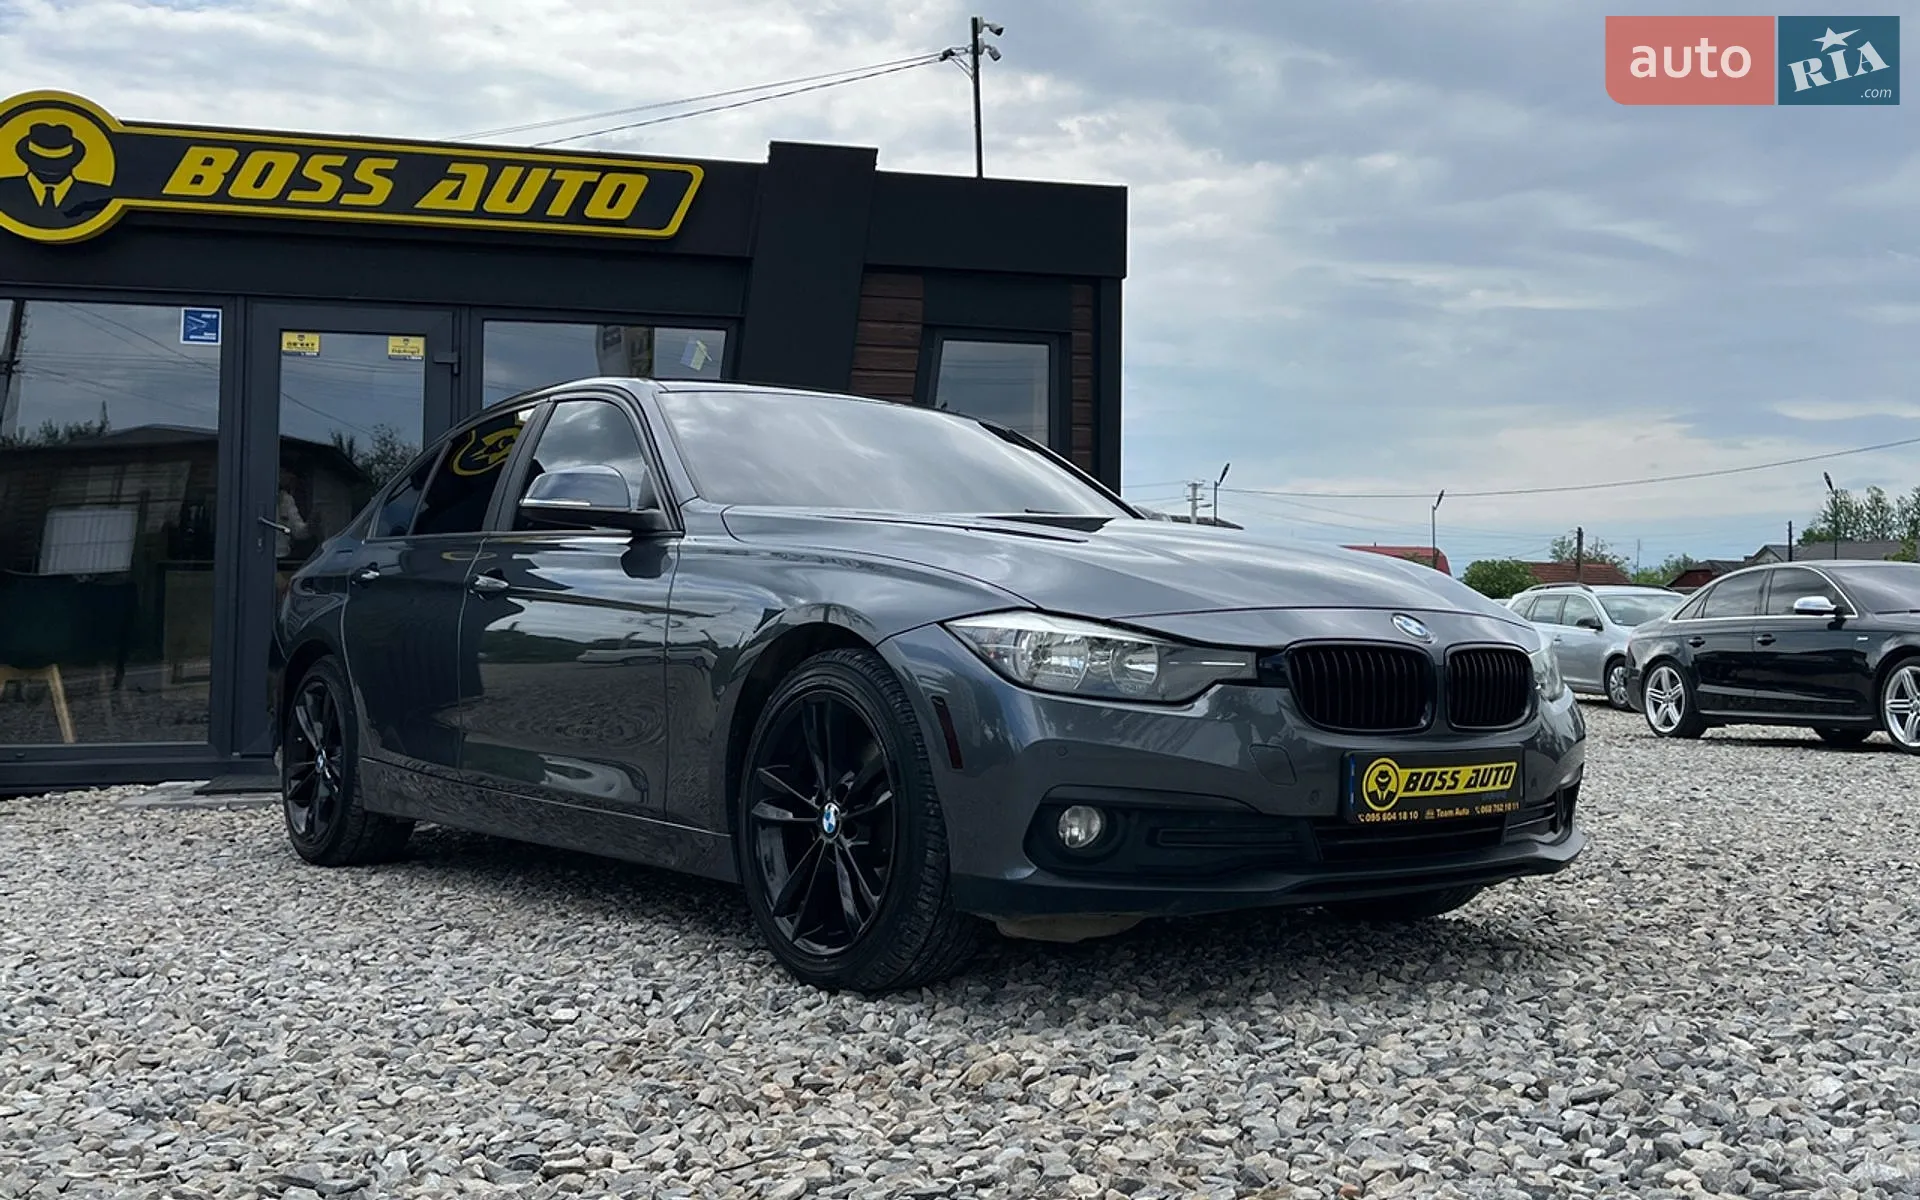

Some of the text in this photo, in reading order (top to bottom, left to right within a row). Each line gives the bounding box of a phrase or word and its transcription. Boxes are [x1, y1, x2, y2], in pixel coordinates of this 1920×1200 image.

[162, 145, 650, 221] BOSS AUTO
[1403, 766, 1514, 793] BOSS AUTO
[1409, 810, 1419, 820] 10
[1436, 808, 1455, 818] Team
